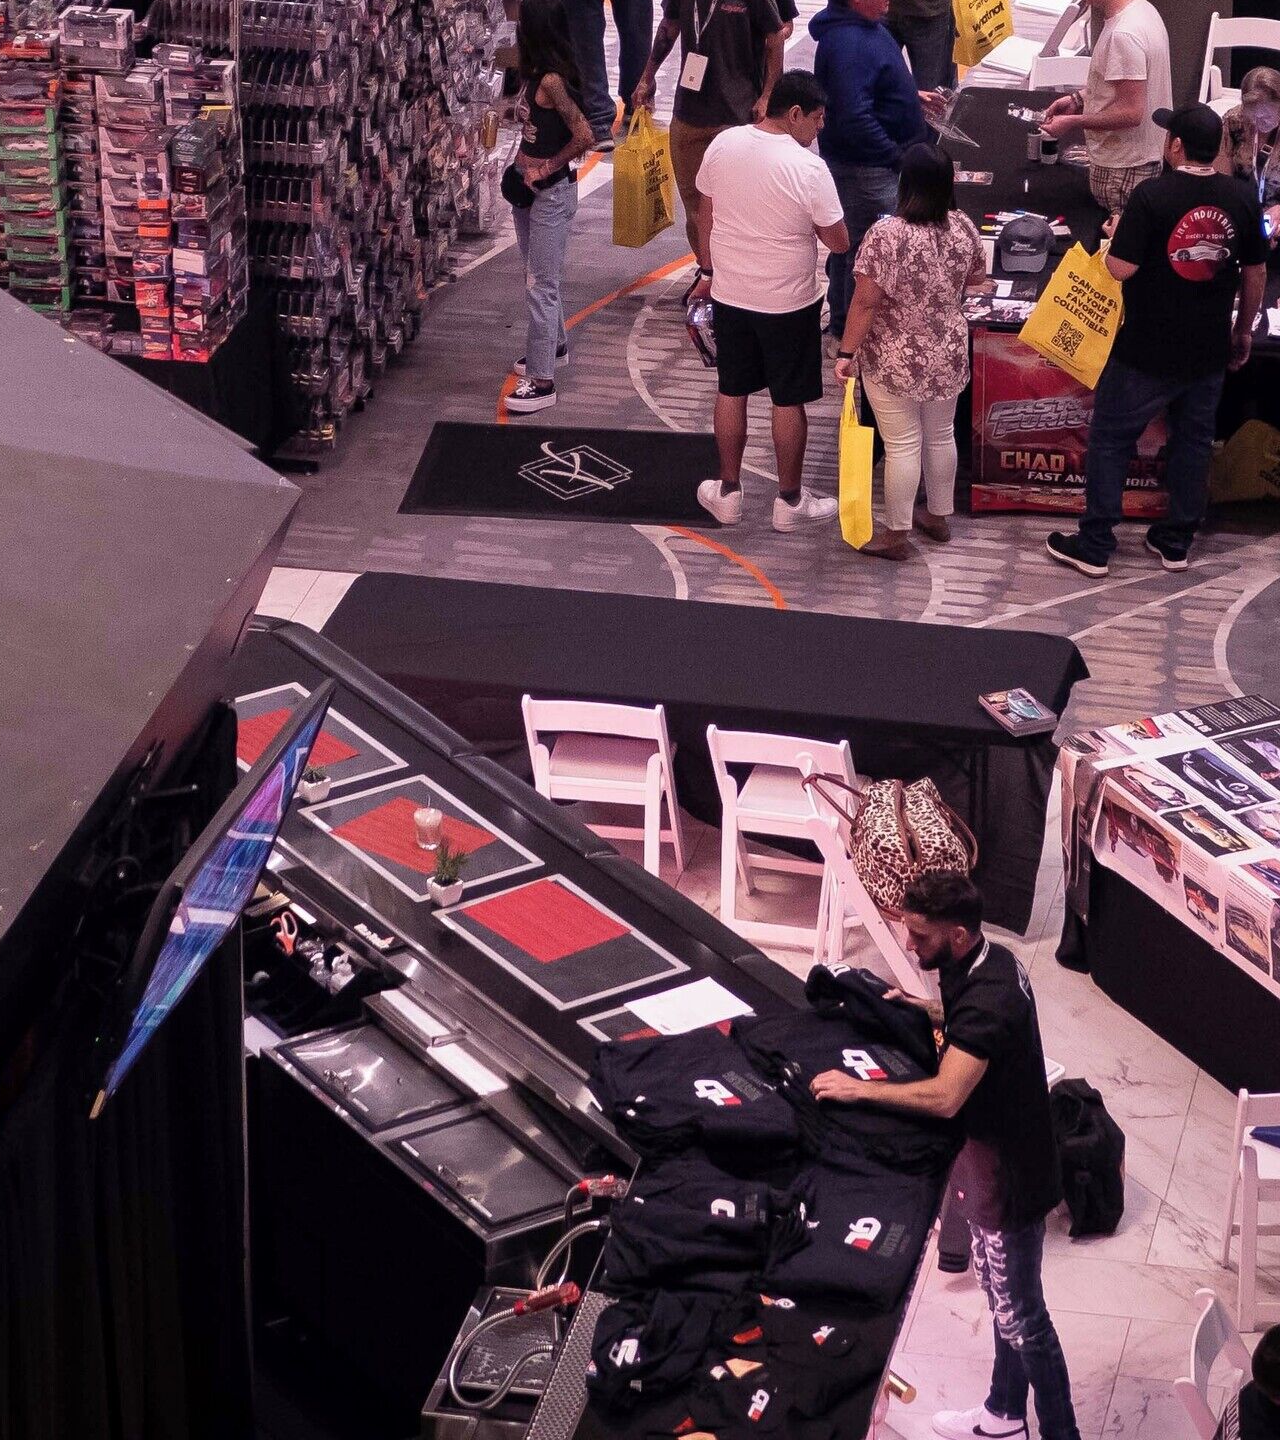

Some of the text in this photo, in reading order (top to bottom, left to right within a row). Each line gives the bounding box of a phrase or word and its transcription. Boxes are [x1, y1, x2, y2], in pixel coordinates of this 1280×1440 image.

[1190, 209, 1236, 239] INDUSTRIES
[1067, 271, 1091, 291] SCAN
[1090, 287, 1109, 303] FOR
[1071, 284, 1111, 316] OFF YOUR
[1053, 295, 1109, 338] COLLECTIBLES
[1066, 292, 1106, 324] FAVORITE
[986, 397, 1071, 423] FAST
[992, 409, 1094, 439] FURIO
[1000, 451, 1065, 472] CHAD
[1028, 471, 1159, 487] FAST AN IOUS
